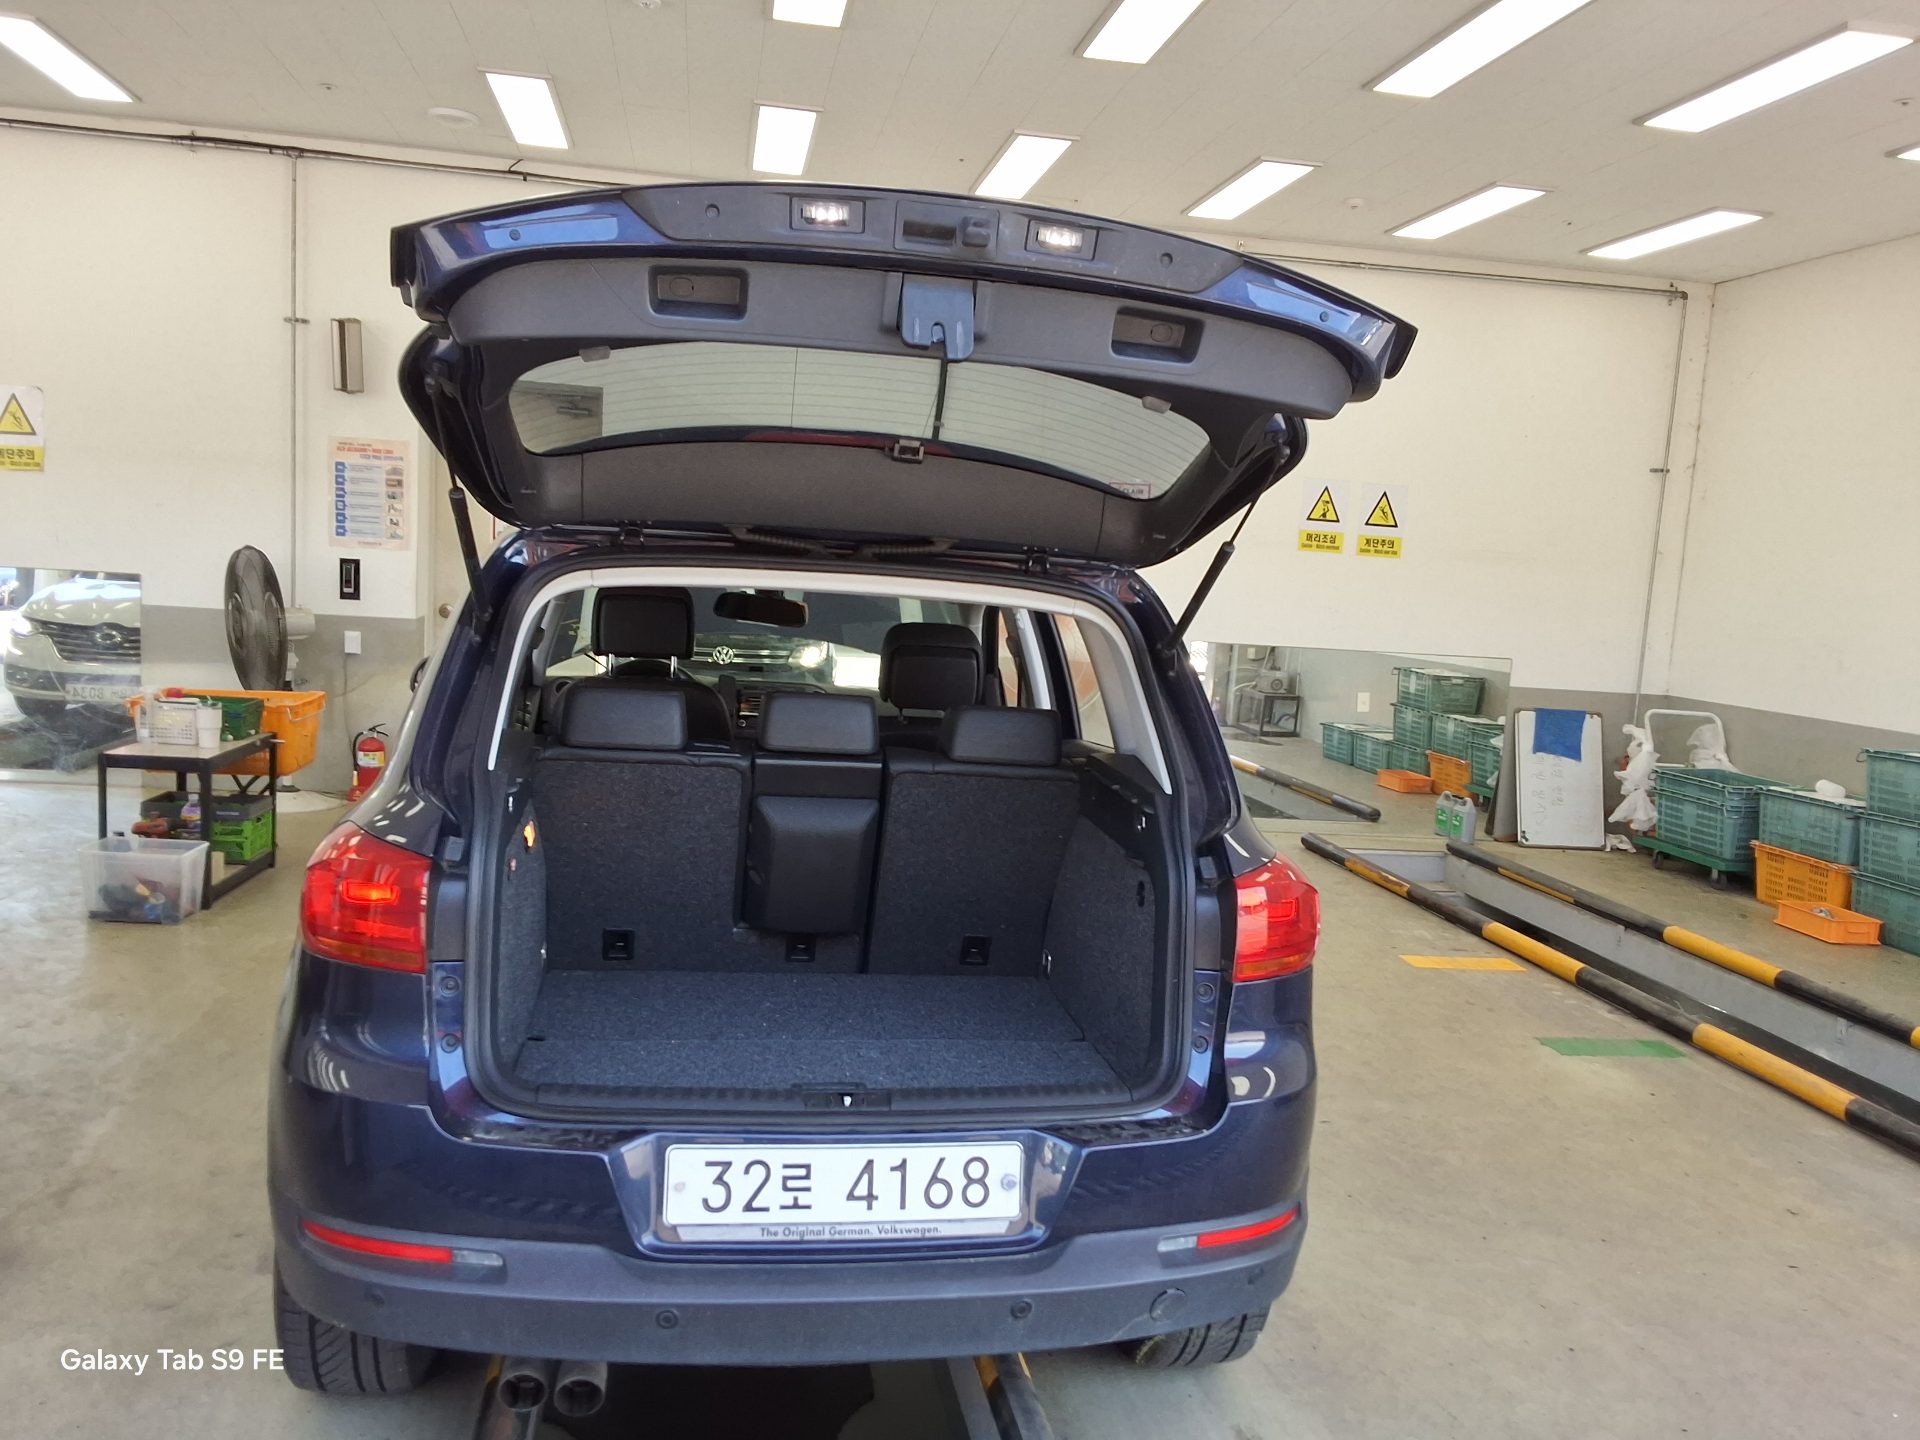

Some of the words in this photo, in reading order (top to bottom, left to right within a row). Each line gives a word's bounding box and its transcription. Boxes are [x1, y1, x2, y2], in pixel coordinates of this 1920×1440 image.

[1306, 532, 1337, 544] 머리조심
[1364, 537, 1395, 549] 계단주의
[702, 1159, 812, 1213] 32로
[846, 1156, 990, 1210] 4168
[760, 1227, 779, 1238] The
[782, 1226, 826, 1240] Original
[828, 1225, 874, 1238] German.
[877, 1224, 942, 1238] Volkswagen.
